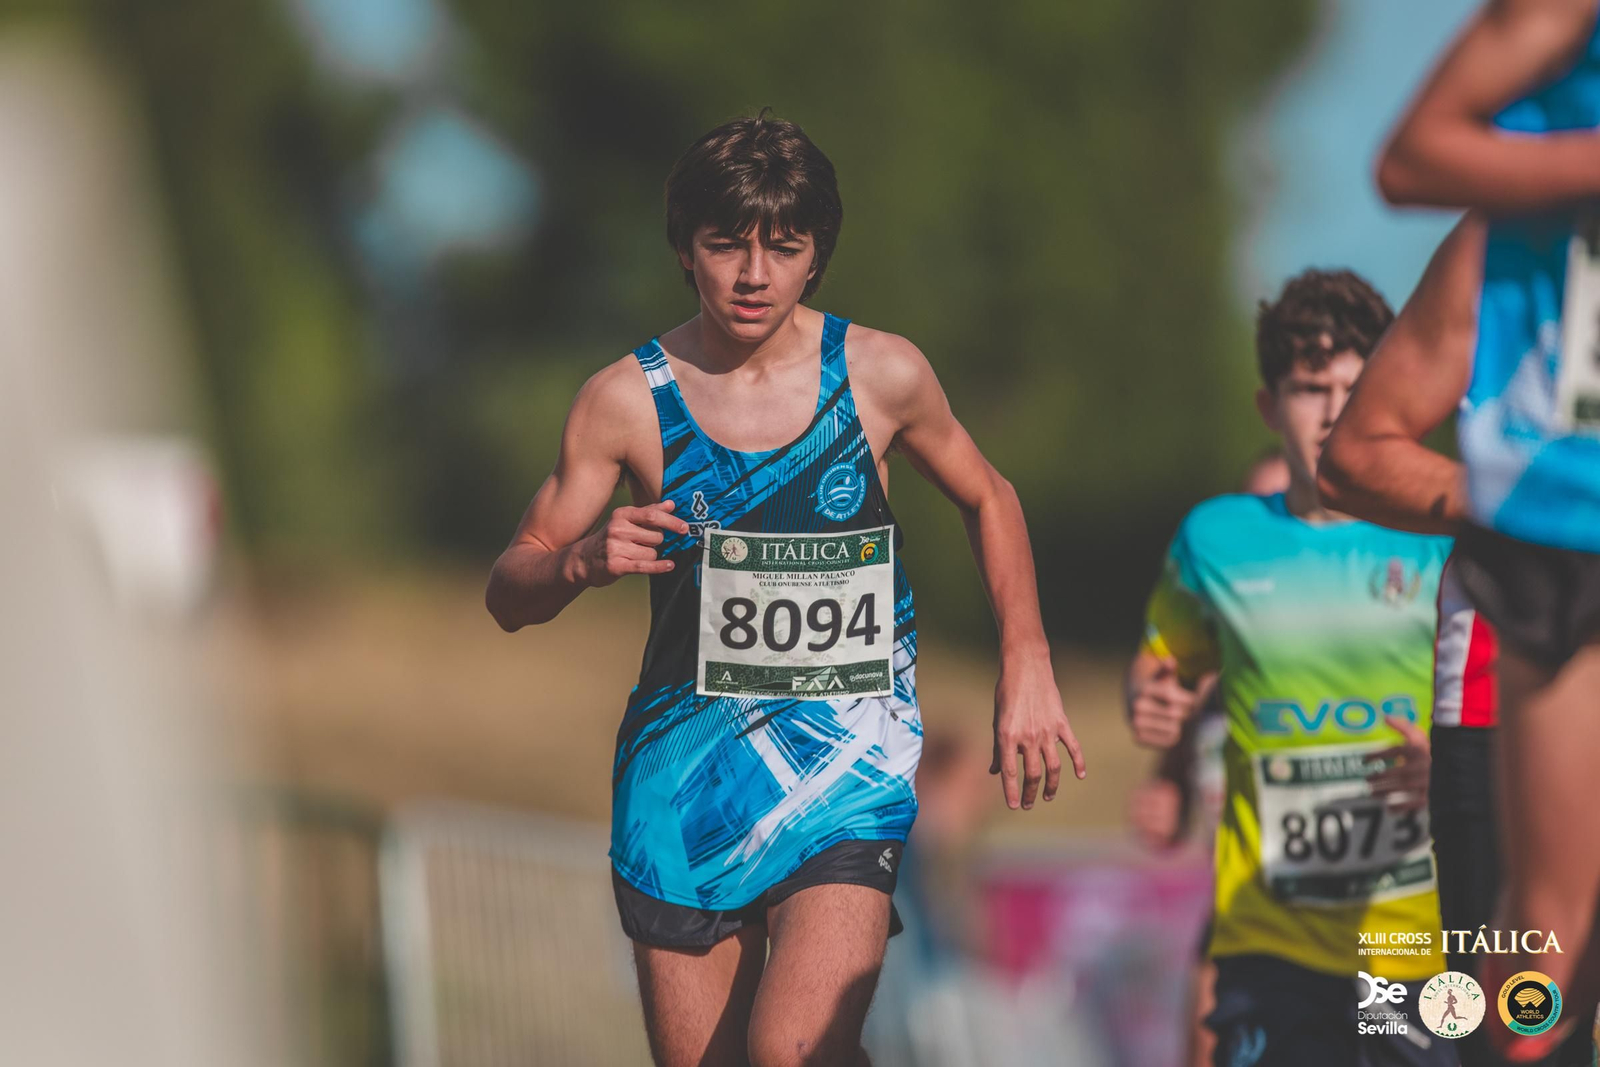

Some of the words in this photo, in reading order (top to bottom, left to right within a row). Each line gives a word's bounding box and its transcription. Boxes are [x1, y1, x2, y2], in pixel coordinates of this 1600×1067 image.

[761, 538, 850, 561] ITÁLICA
[752, 572, 785, 580] MIGUEL
[787, 572, 819, 580] MILLAN
[820, 570, 856, 580] PALANCO
[813, 579, 850, 587] ATLETISMO
[719, 592, 882, 653] 8094
[1281, 806, 1425, 864] 8073
